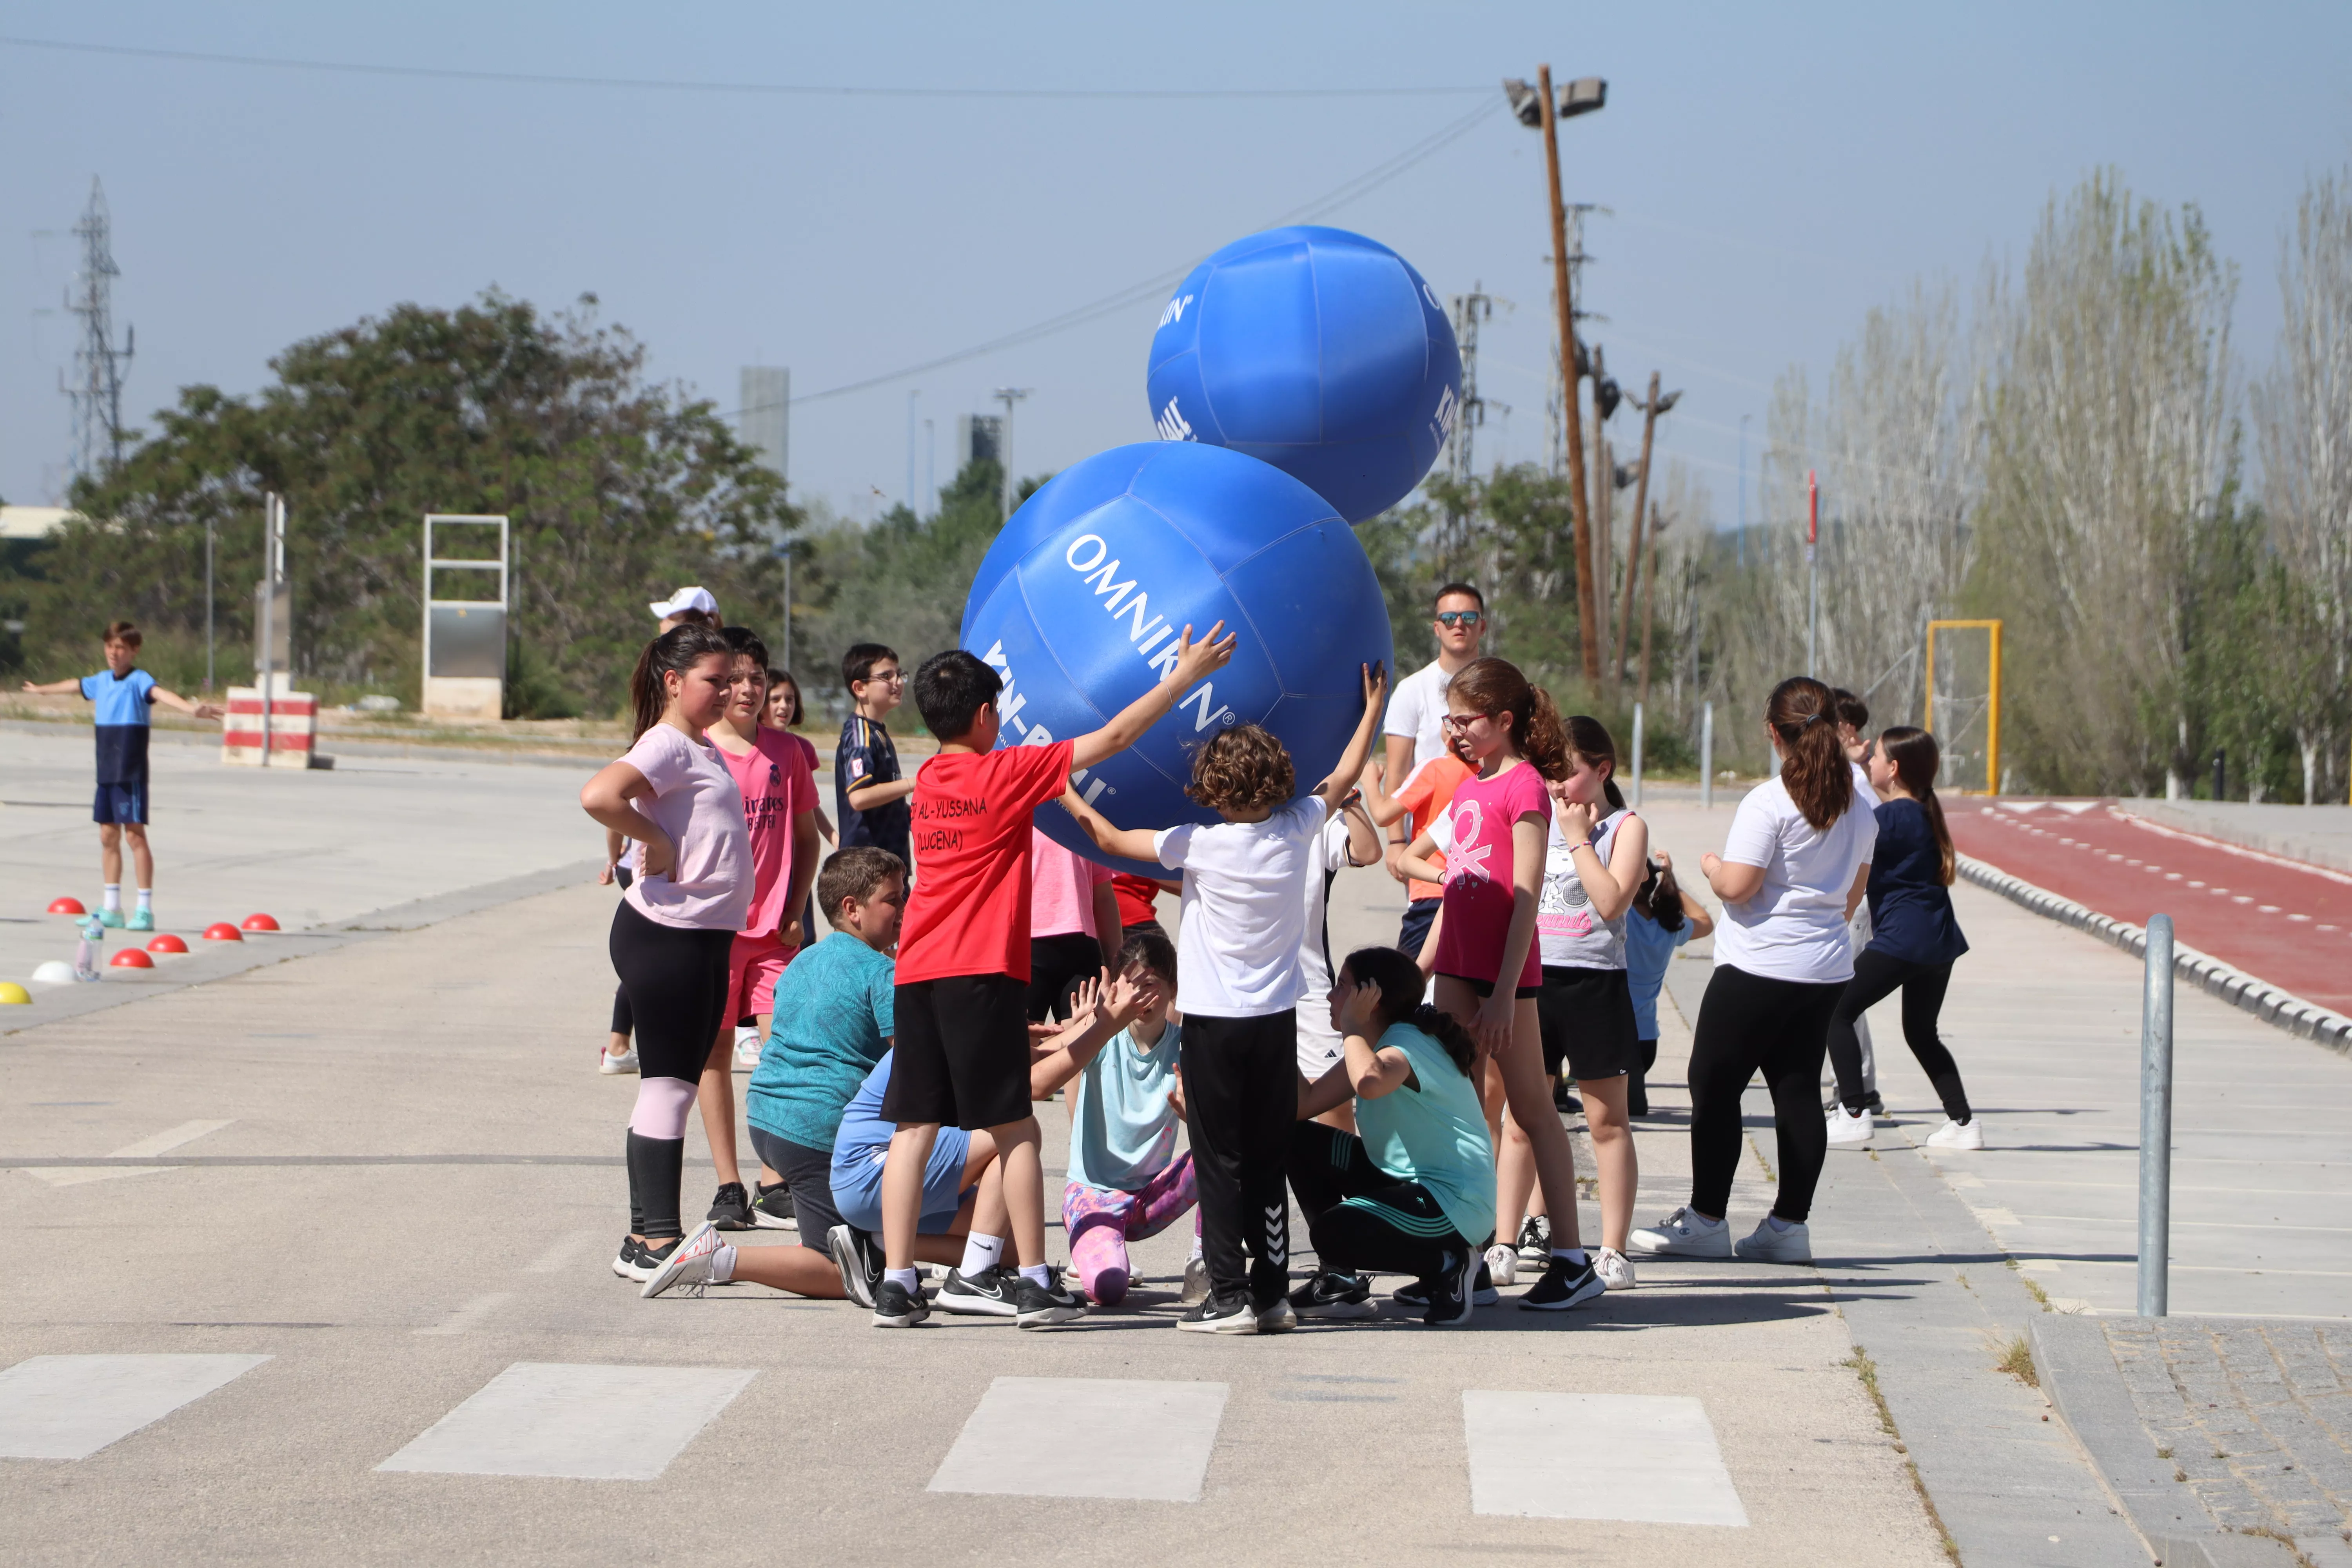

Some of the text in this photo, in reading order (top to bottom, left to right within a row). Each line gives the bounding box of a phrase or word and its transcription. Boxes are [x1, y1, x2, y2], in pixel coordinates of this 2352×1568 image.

[742, 795, 784, 815] irates
[918, 797, 987, 820] AL-YUSSANA
[918, 829, 963, 855] (LUCENA)
